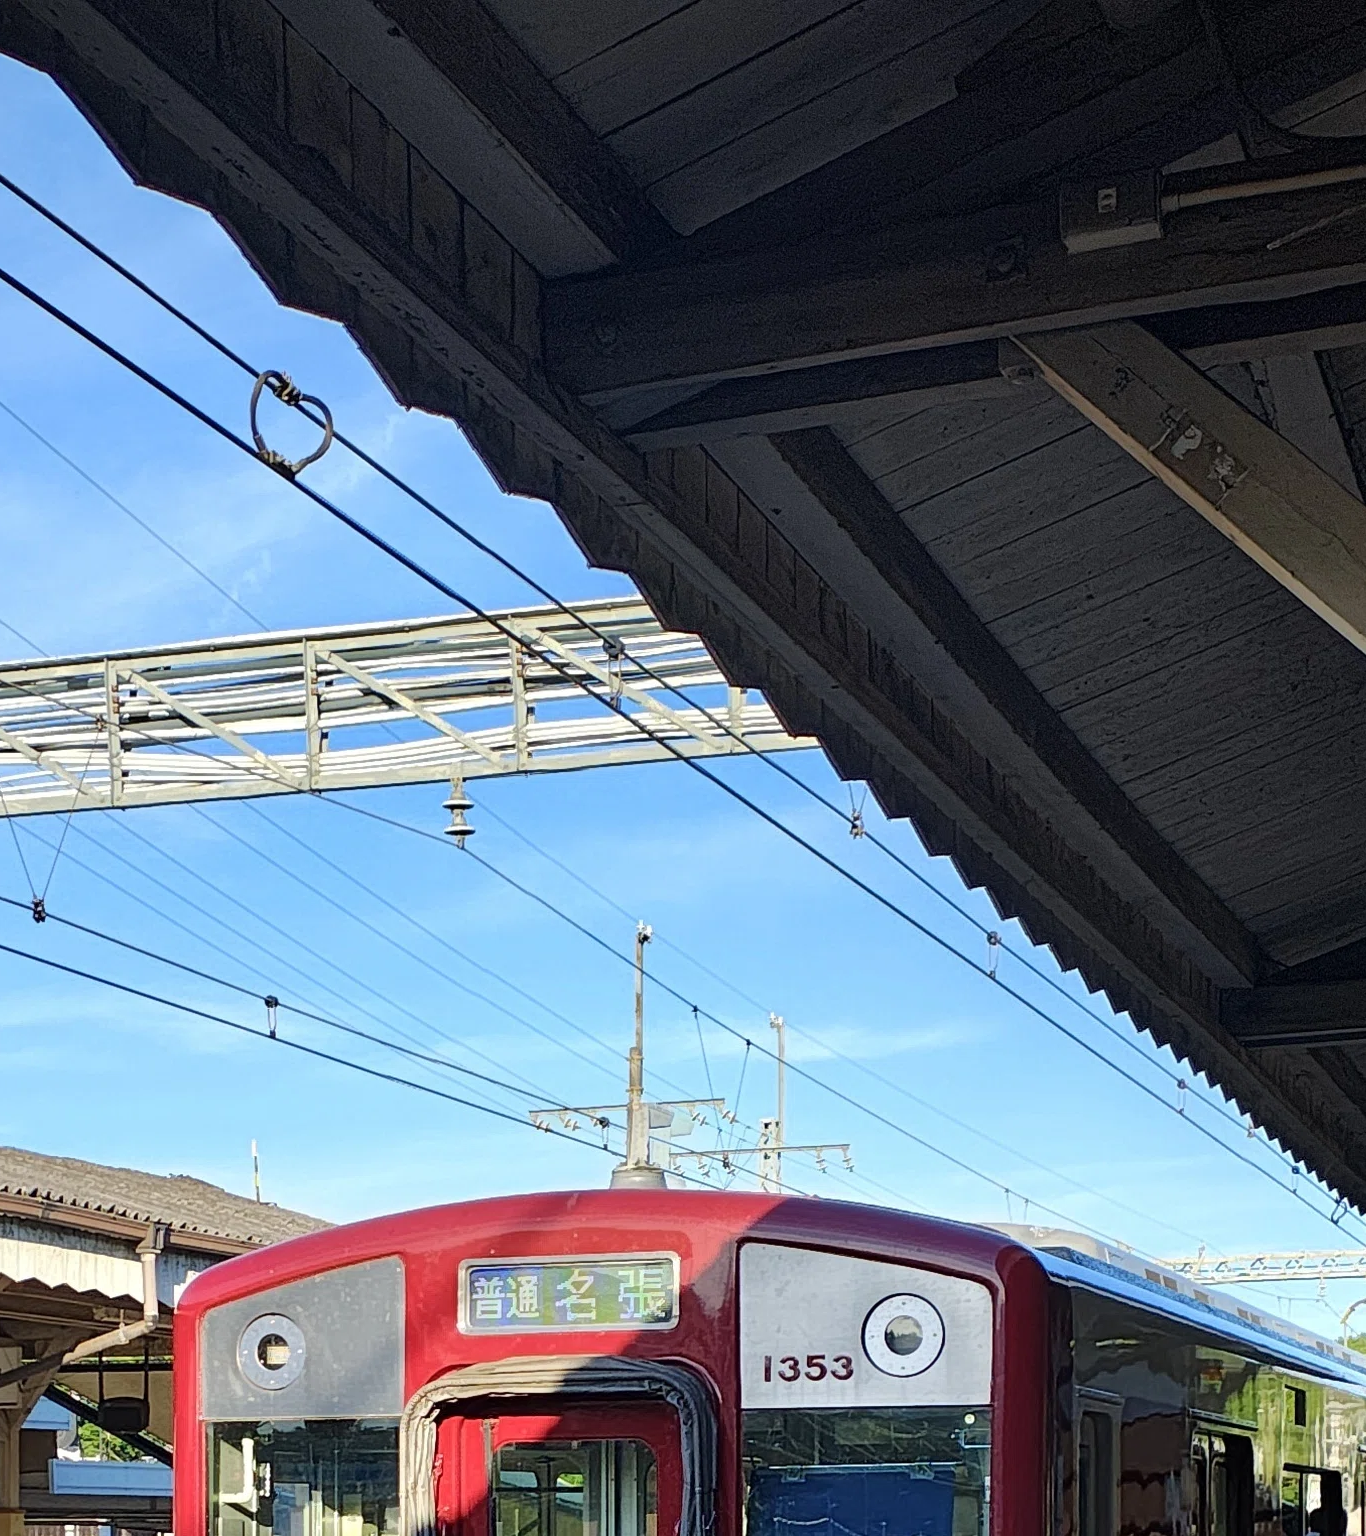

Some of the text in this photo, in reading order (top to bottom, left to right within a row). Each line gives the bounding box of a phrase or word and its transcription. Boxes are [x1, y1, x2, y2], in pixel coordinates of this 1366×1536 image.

[472, 1267, 666, 1321] 普通 名張
[763, 1354, 854, 1382] 1353
